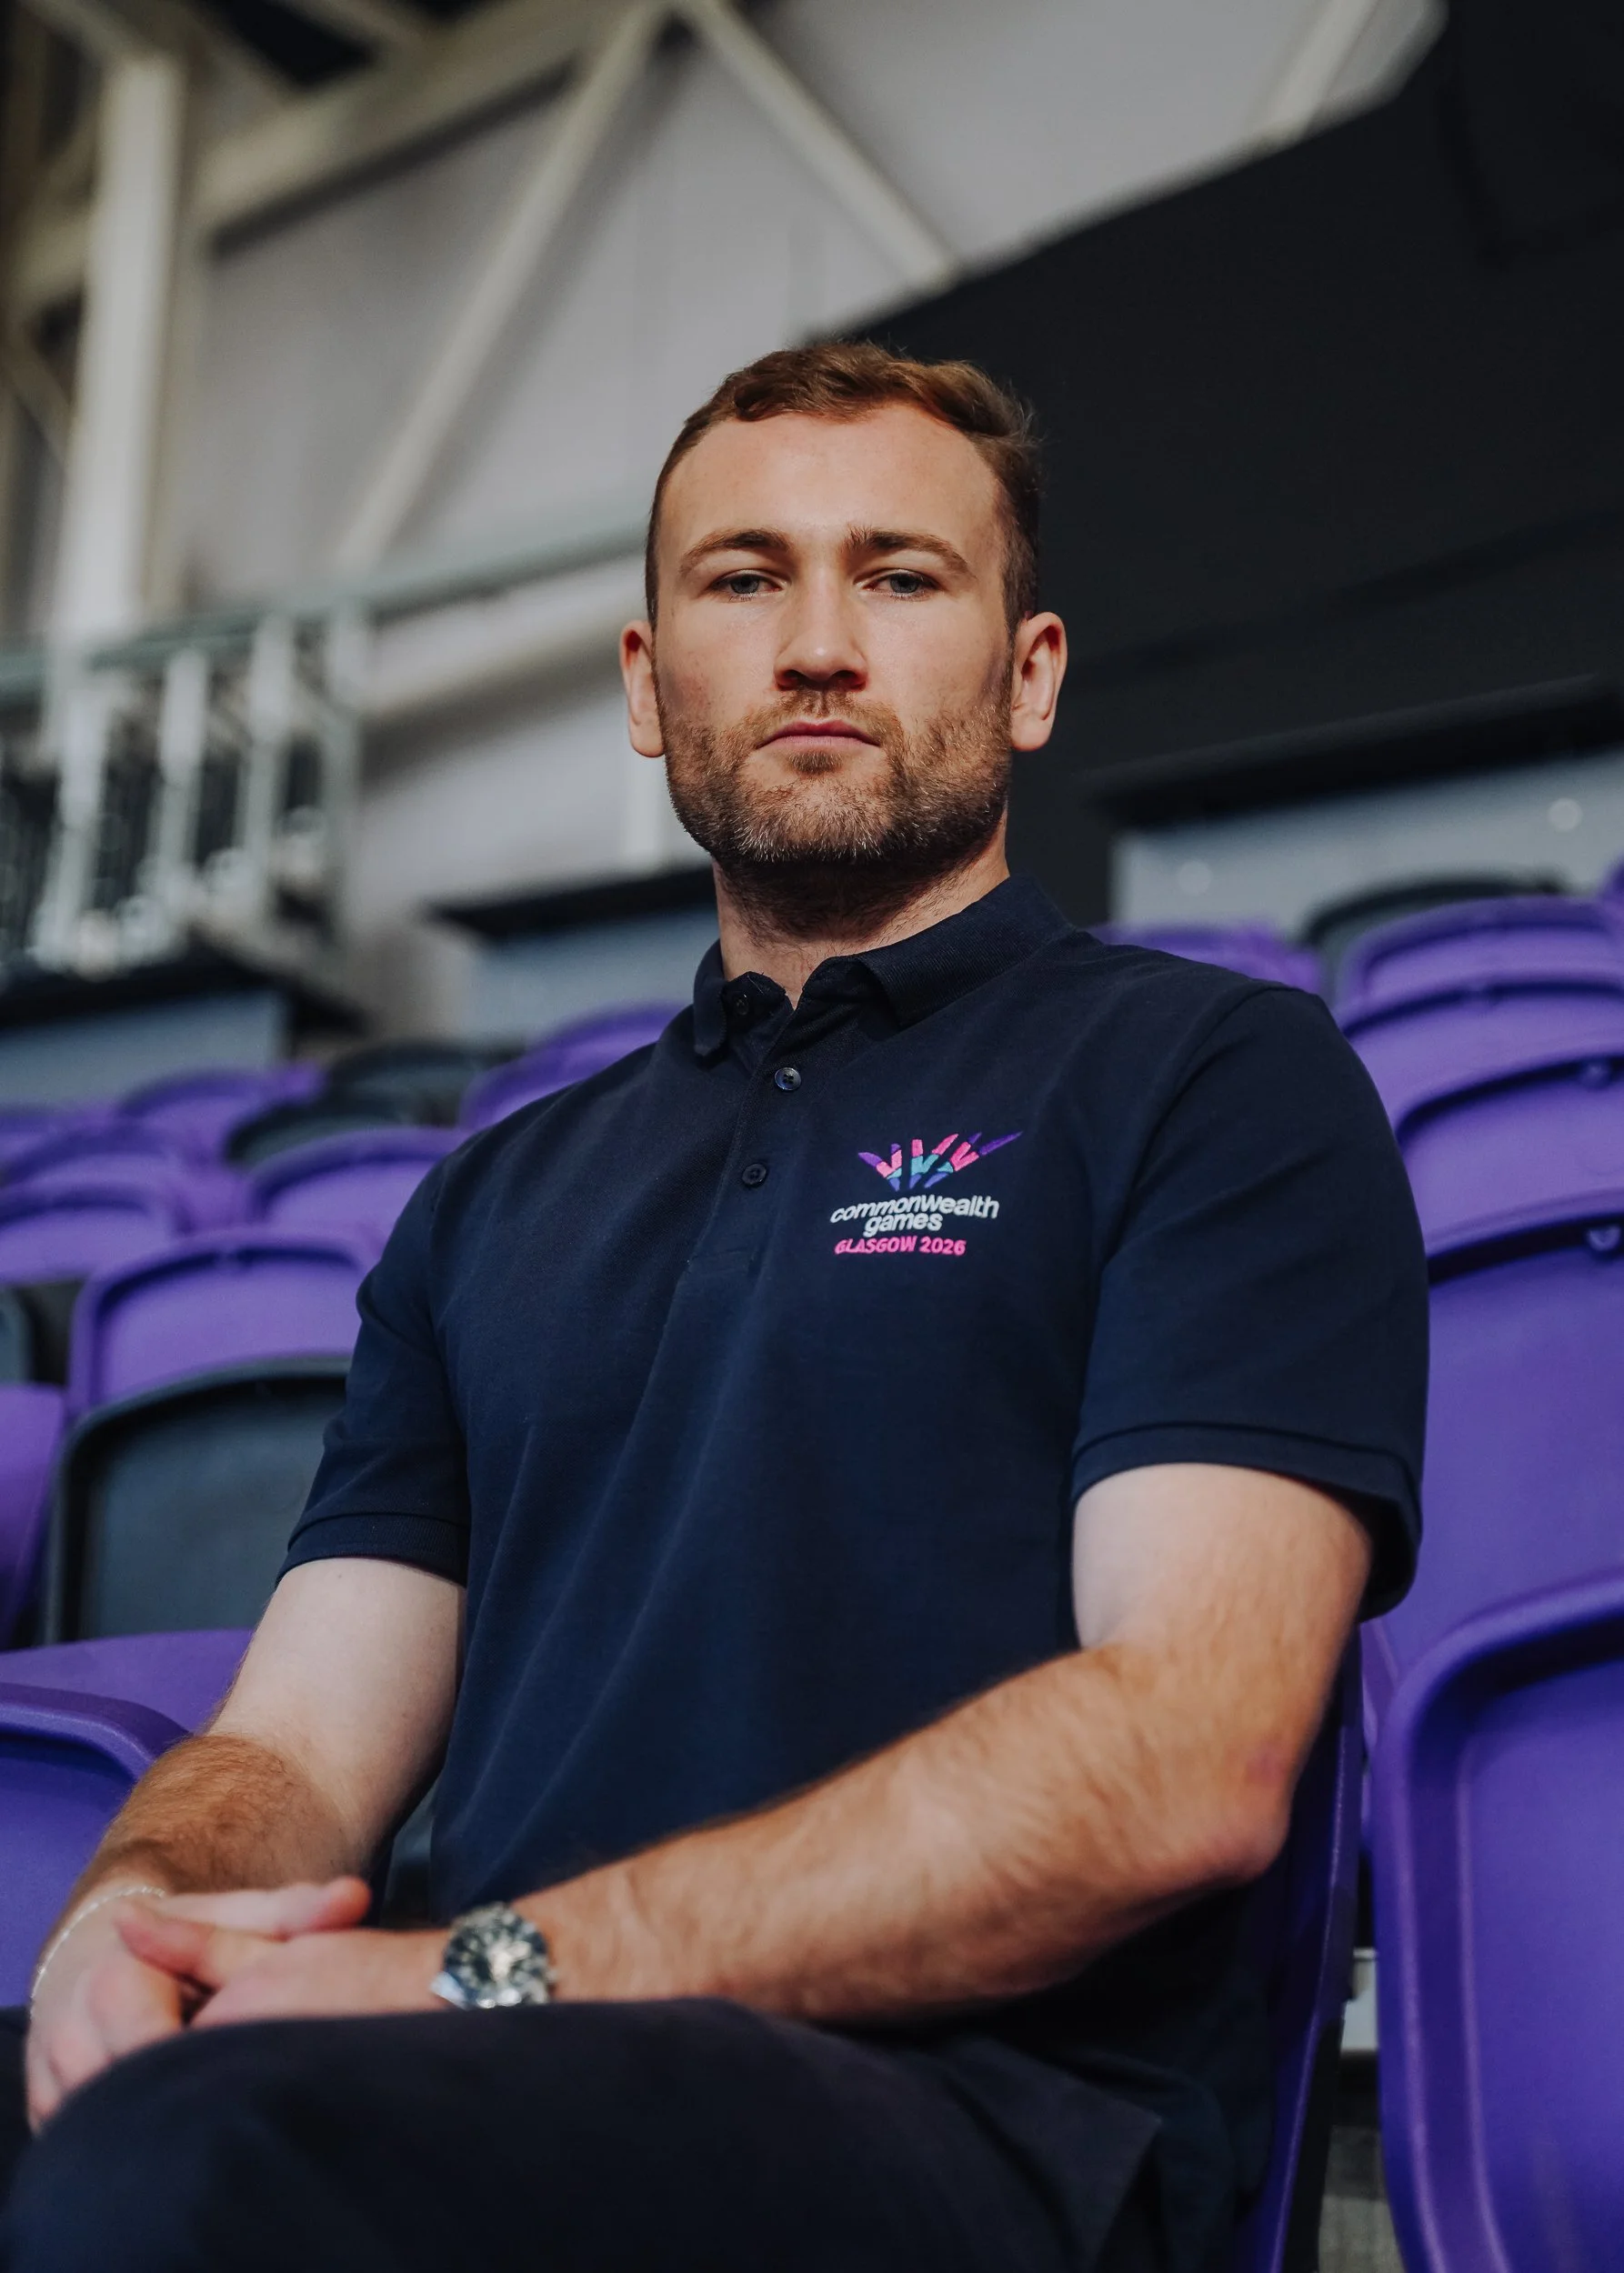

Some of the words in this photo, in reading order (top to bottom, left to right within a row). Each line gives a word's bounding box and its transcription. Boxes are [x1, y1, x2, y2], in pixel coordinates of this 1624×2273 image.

[829, 1194, 1000, 1223] commonwealth
[863, 1212, 943, 1237] games
[834, 1236, 917, 1255] GLASGOW
[919, 1236, 967, 1256] 2026
